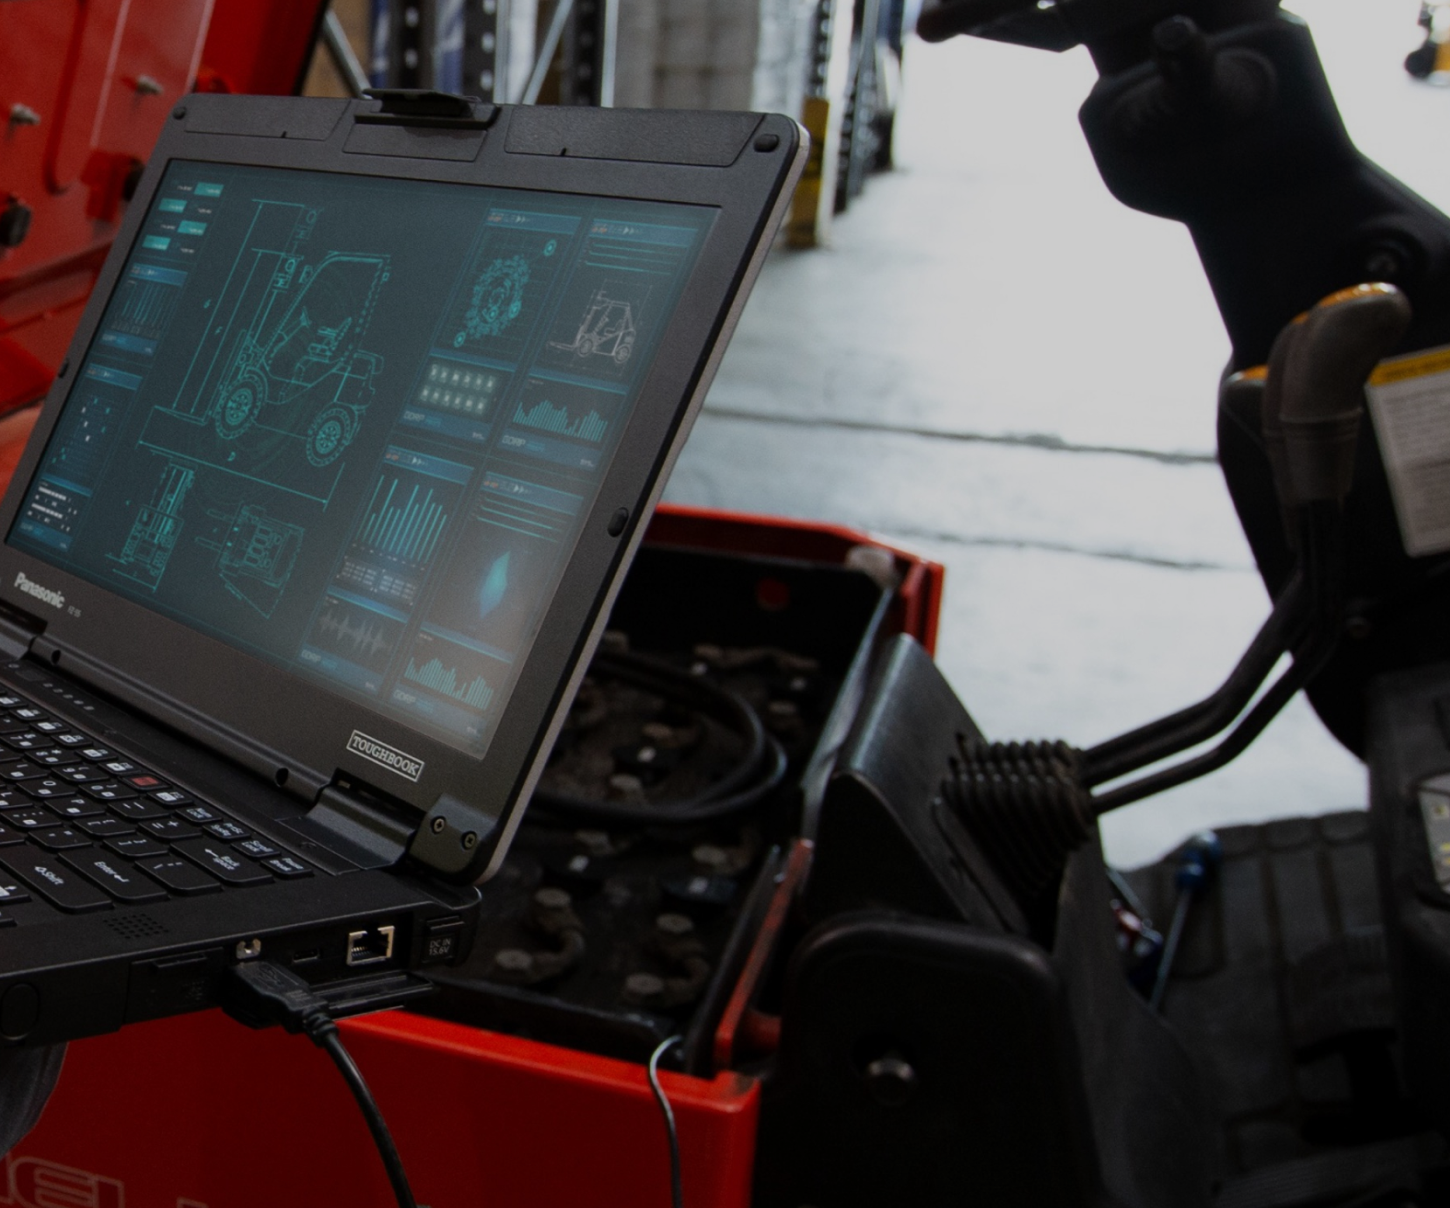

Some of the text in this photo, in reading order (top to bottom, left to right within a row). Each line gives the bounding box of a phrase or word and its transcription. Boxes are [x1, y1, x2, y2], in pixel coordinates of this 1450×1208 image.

[14, 571, 65, 609] Panasonic
[352, 735, 420, 776] TOUGHBOOK
[42, 869, 64, 886] Shift
[94, 861, 117, 876] Enter
